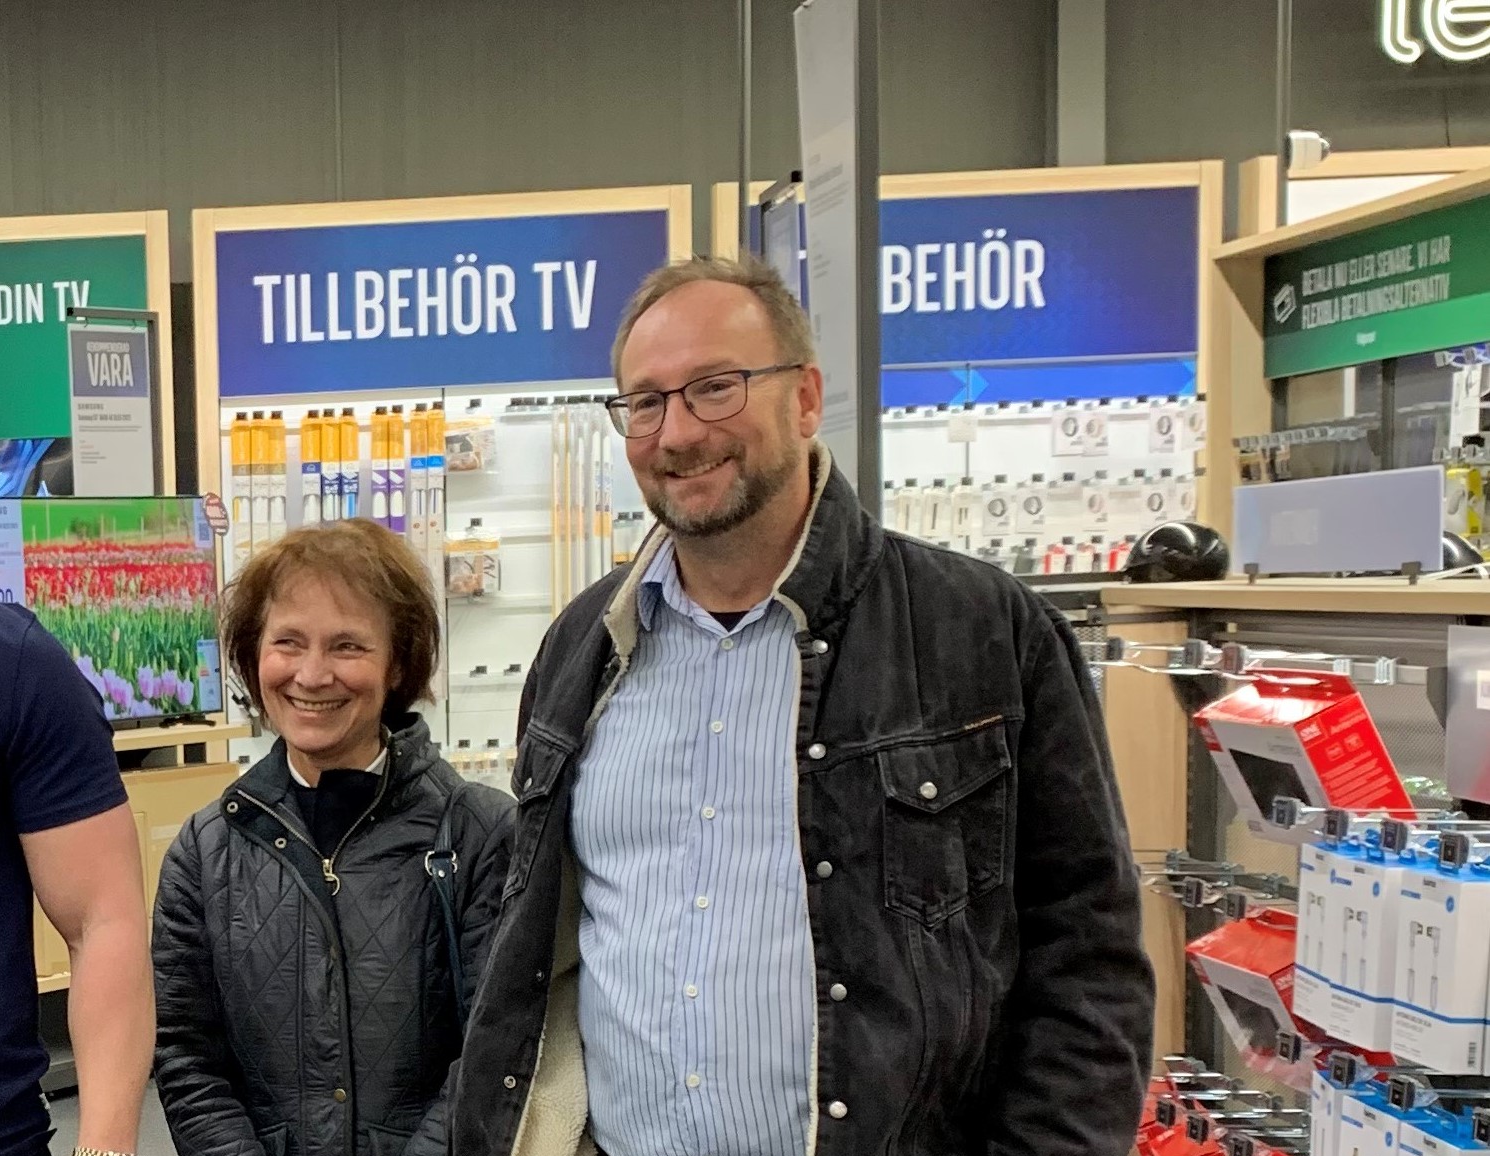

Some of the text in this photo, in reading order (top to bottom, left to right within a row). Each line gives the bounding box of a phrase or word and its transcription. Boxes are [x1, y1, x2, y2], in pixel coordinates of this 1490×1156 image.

[53, 280, 90, 322] TV
[254, 253, 597, 344] TILLBEHÖR TV
[881, 228, 1046, 314] BEHÖR
[87, 352, 134, 387] VARA
